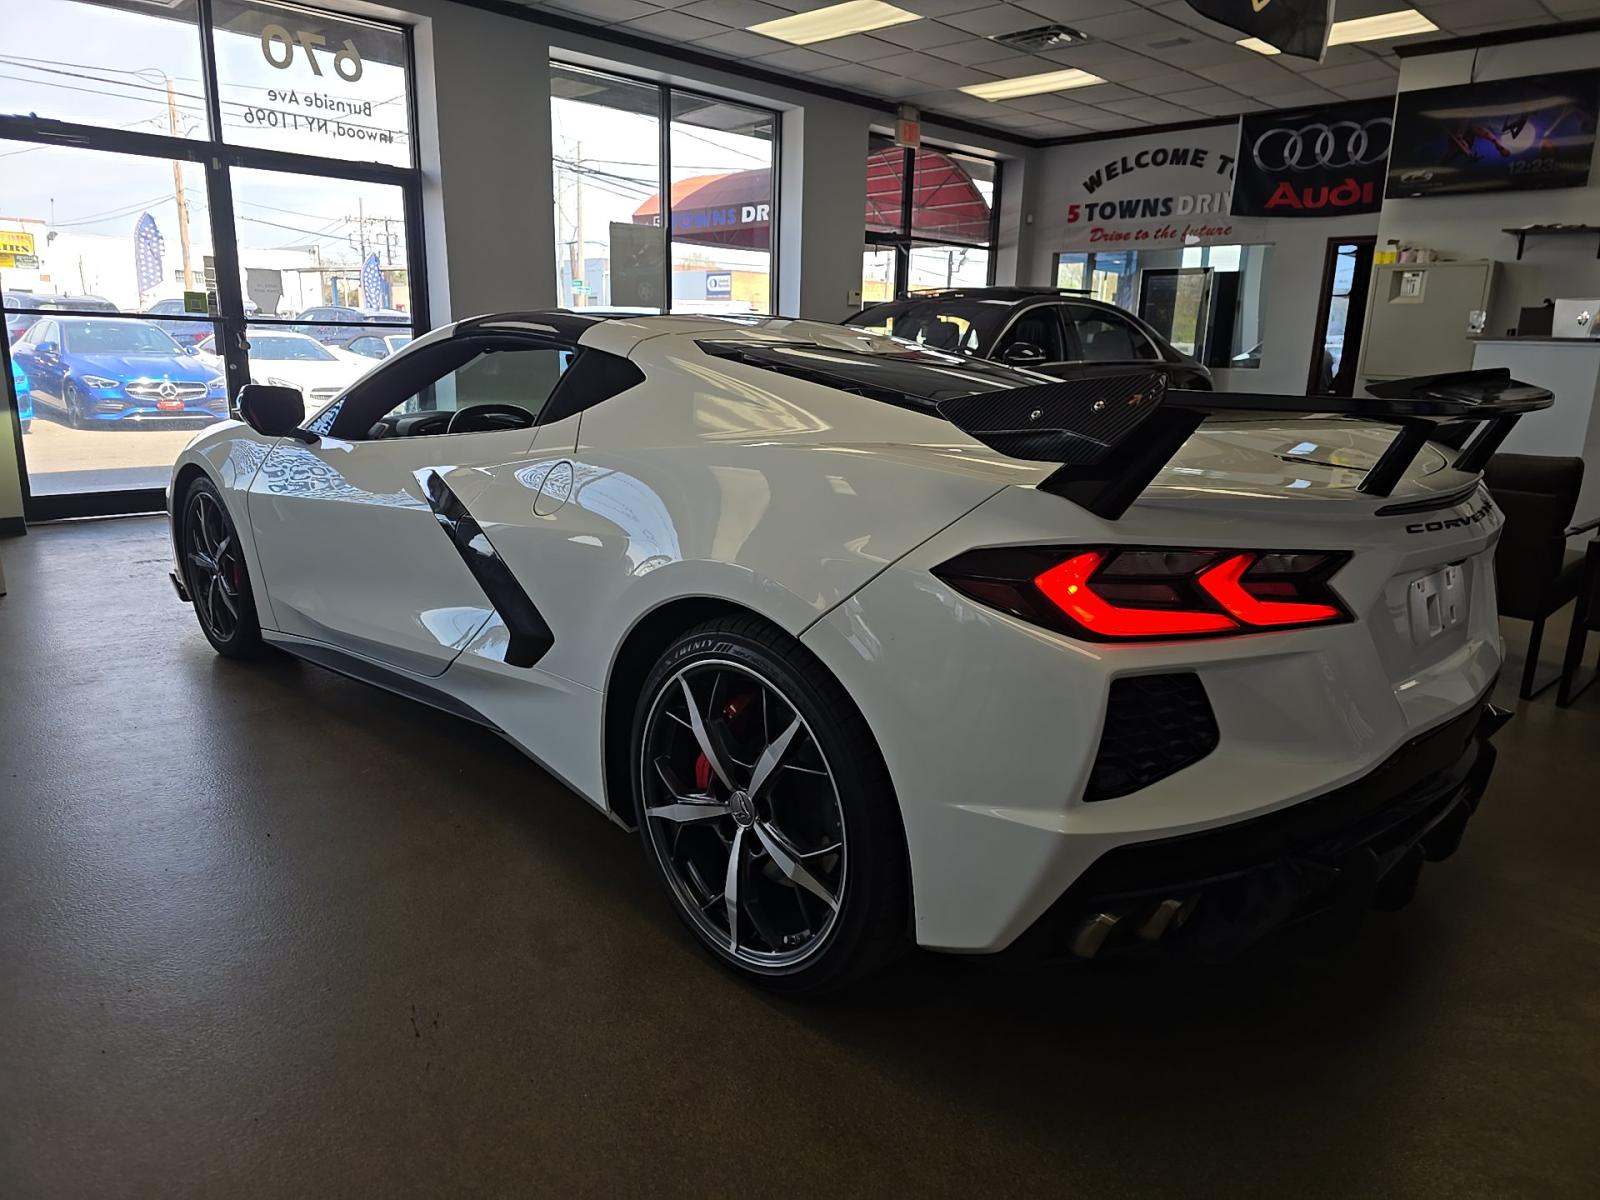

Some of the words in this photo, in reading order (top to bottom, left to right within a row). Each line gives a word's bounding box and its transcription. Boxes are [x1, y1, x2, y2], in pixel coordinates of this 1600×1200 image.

[1082, 148, 1208, 194] WELCOME
[1508, 158, 1554, 175] 12:23
[1264, 178, 1374, 209] Audi
[1067, 204, 1080, 223] 5
[1085, 197, 1174, 222] TOWNS
[1089, 225, 1131, 243] Drive
[1134, 228, 1150, 241] to
[1153, 225, 1177, 240] the
[1181, 223, 1232, 242] future
